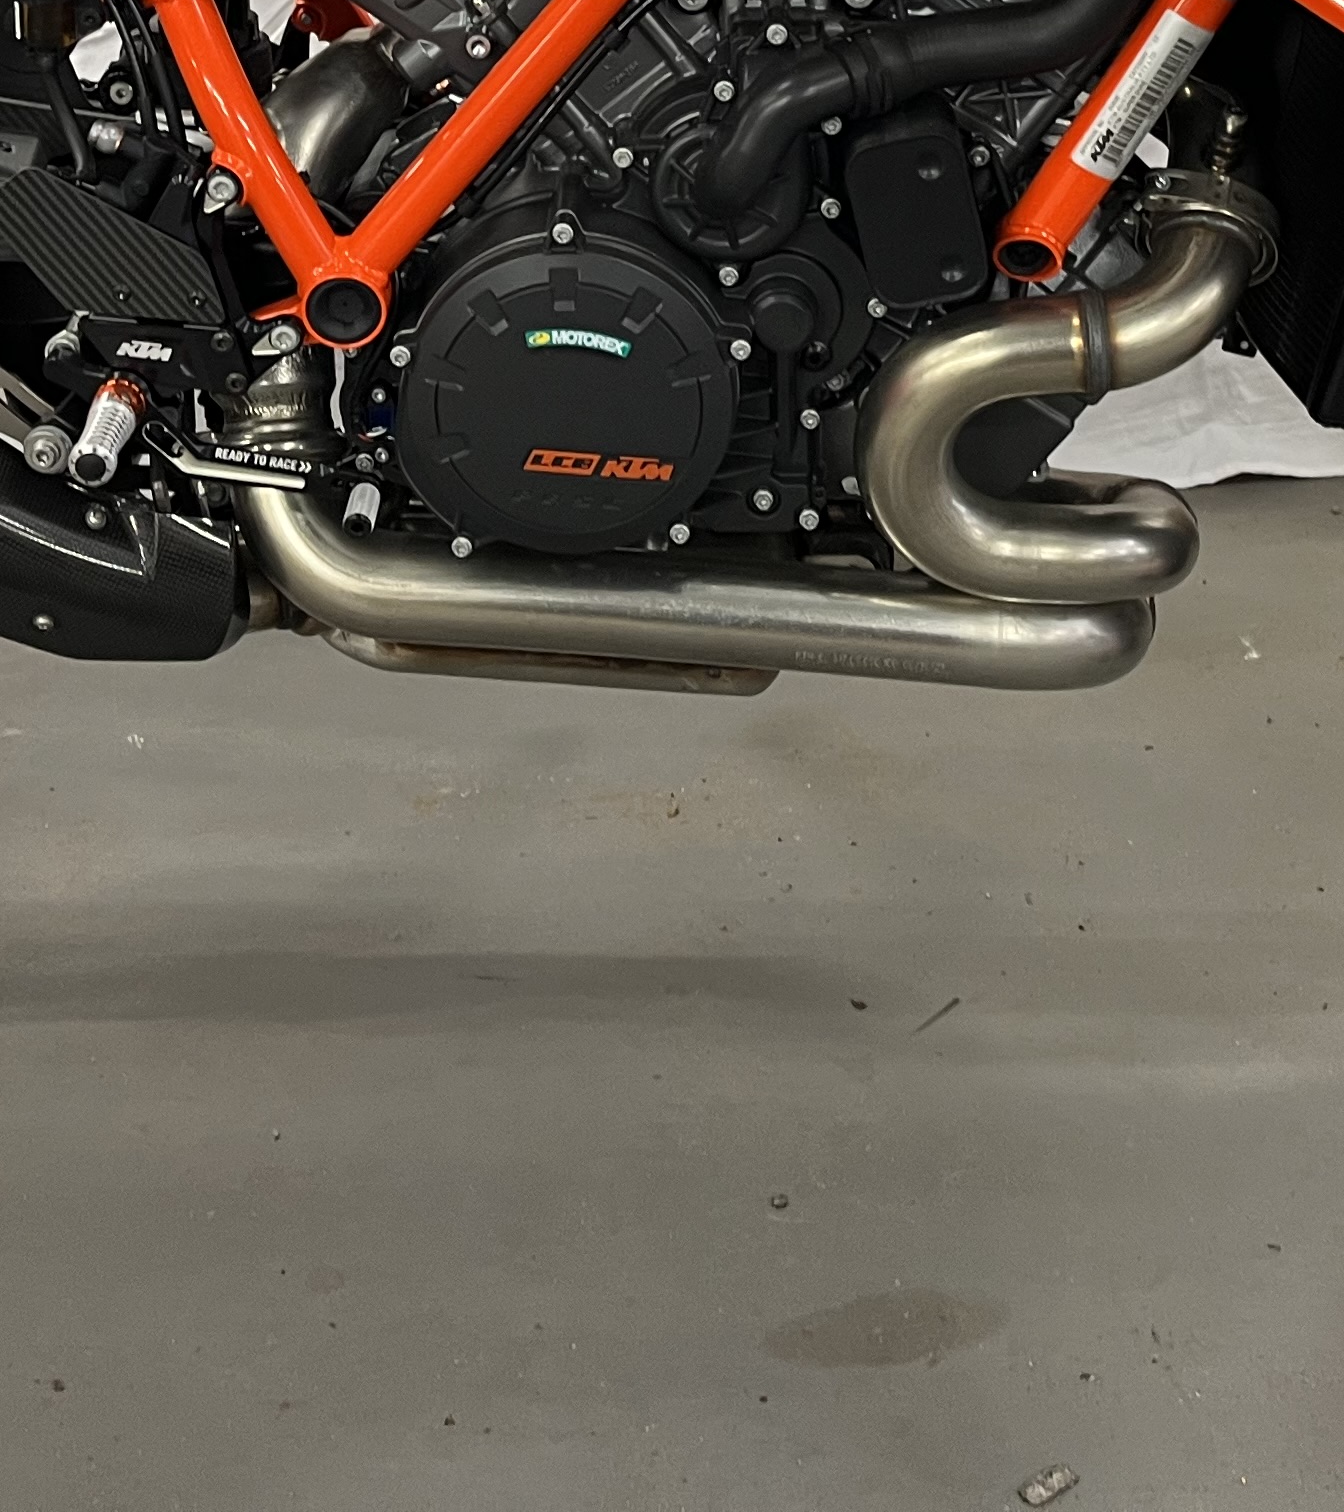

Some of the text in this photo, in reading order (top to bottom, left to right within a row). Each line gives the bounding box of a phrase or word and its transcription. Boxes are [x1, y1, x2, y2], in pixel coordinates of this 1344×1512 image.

[116, 340, 173, 362] KTM
[551, 330, 629, 357] MOTOREX
[214, 447, 298, 472] READY TO RACE
[601, 456, 675, 481] KTM
